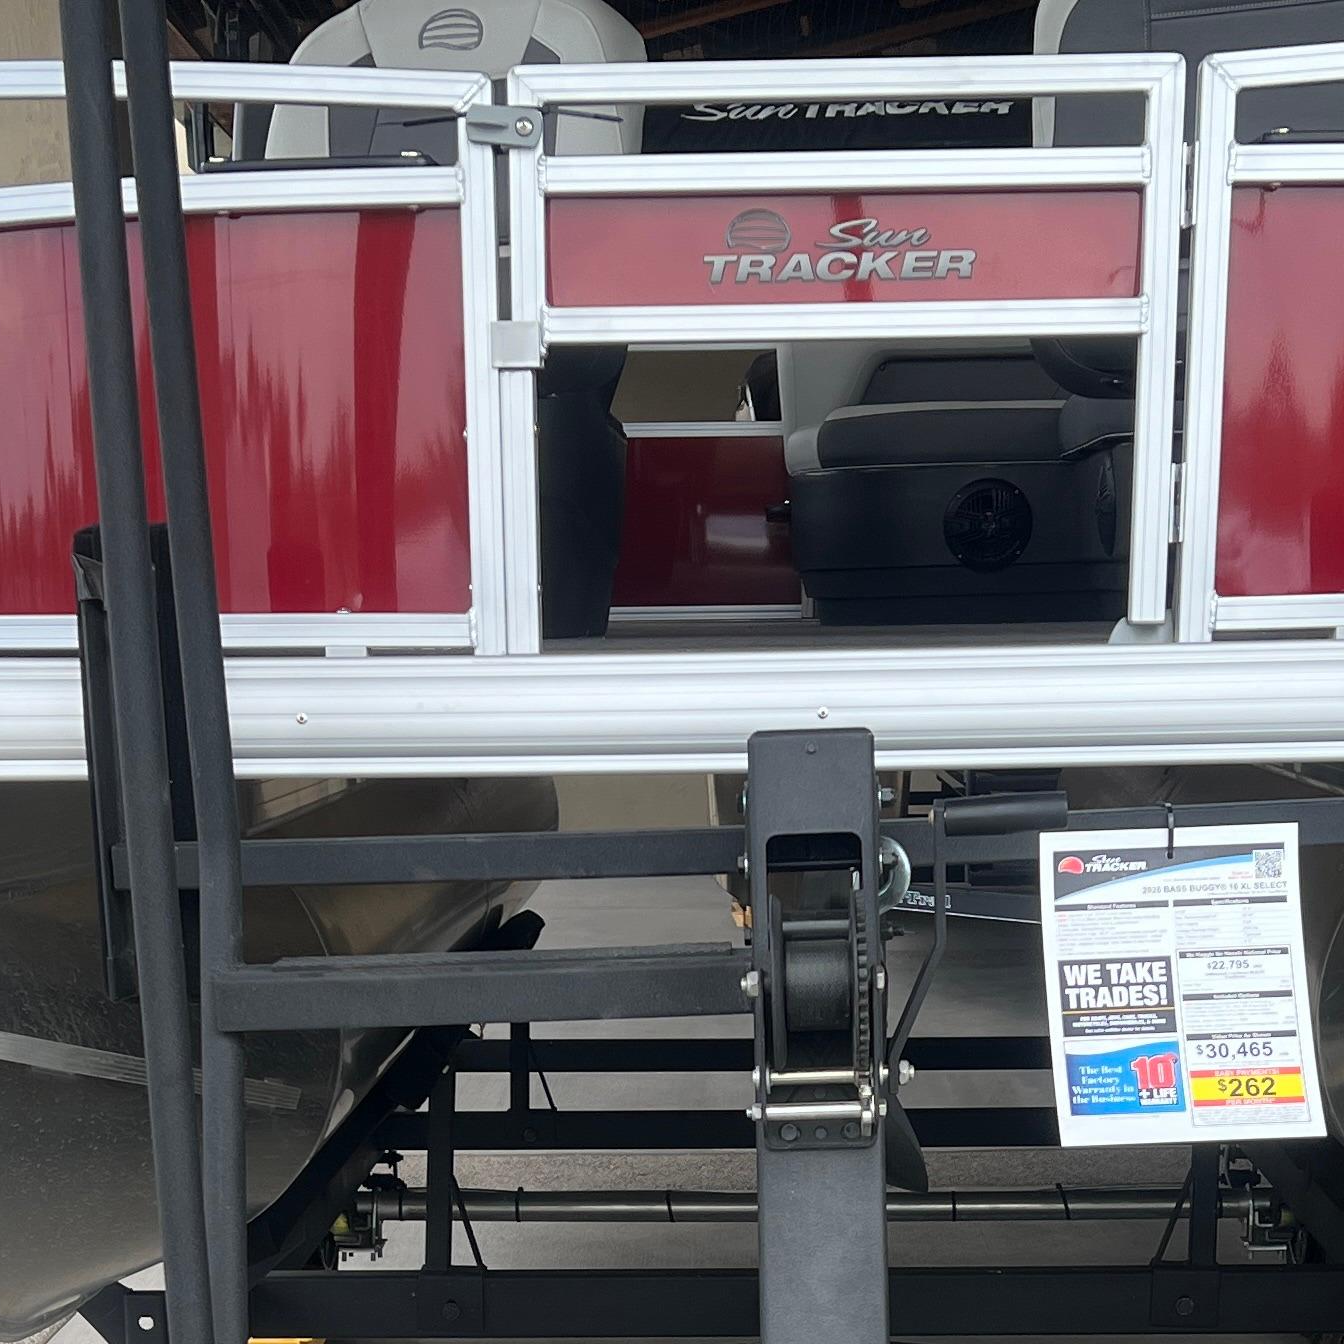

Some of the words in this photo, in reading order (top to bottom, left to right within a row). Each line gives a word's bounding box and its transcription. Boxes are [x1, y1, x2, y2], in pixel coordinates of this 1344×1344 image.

[681, 101, 799, 121] Sun
[815, 218, 932, 250] Sun
[703, 249, 977, 285] TRACKER
[1085, 861, 1148, 873] TRACKER
[1163, 884, 1187, 893] BASS
[1240, 882, 1251, 890] XL
[1253, 881, 1288, 890] SELECT
[1063, 964, 1103, 986] WE
[1106, 961, 1168, 985] TAKE
[1064, 984, 1168, 1009] TRADES!
[1196, 1041, 1273, 1060] $30,465
[1079, 1066, 1099, 1075] The
[1101, 1065, 1122, 1074] Best
[1131, 1053, 1178, 1088] 10
[1214, 1069, 1235, 1077] EASY
[1081, 1074, 1121, 1085] Factory
[1217, 1076, 1277, 1097] $262
[1072, 1085, 1121, 1096] Warranty
[1124, 1084, 1135, 1093] in
[1152, 1087, 1177, 1099] LIFE
[1072, 1094, 1089, 1104] the
[1091, 1093, 1137, 1103] Business
